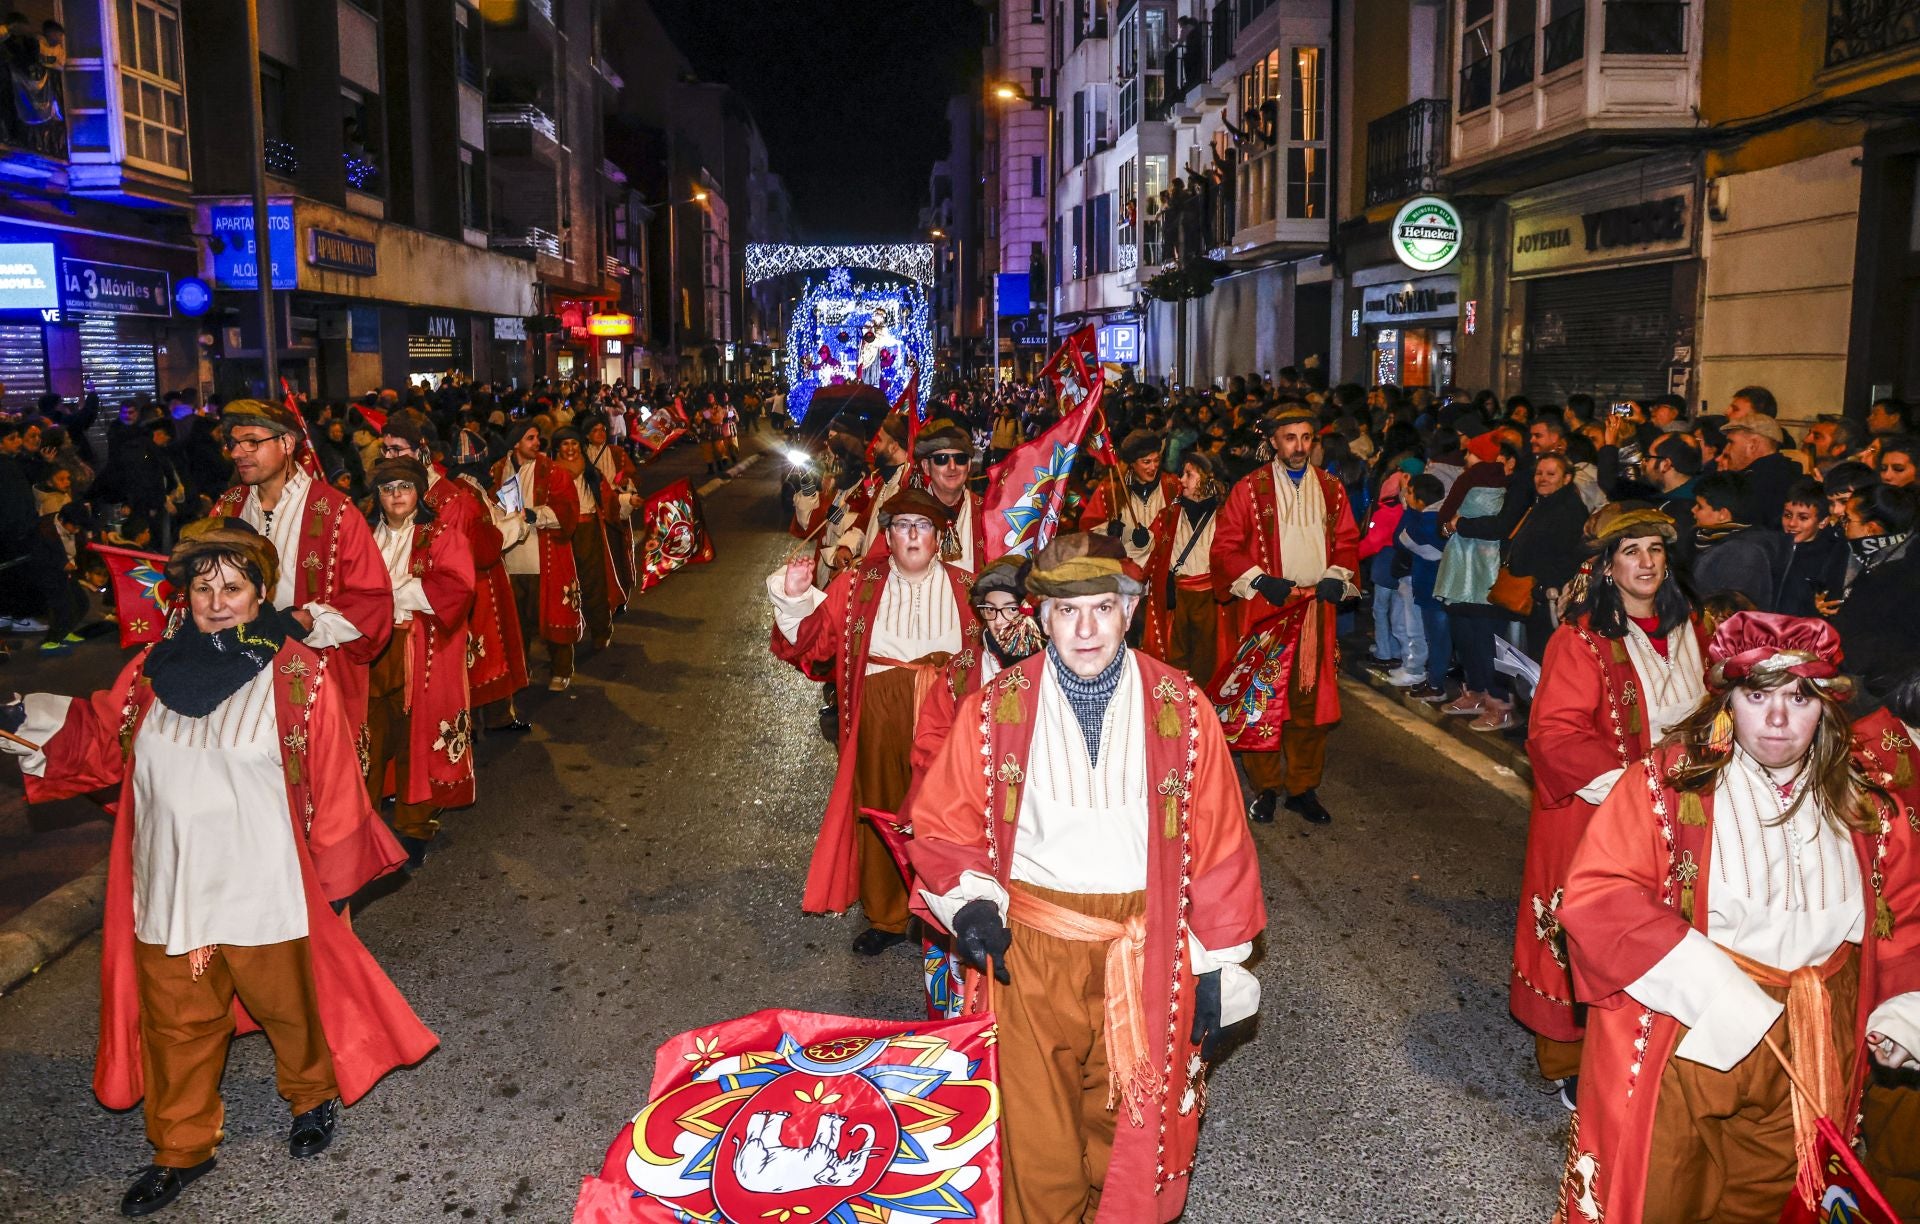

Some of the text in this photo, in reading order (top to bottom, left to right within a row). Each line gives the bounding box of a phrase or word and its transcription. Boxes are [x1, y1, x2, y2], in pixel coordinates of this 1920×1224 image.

[1404, 226, 1455, 240] Heineken
[84, 269, 98, 299] 3
[100, 277, 150, 299] Móviles
[428, 316, 456, 337] ANYA
[1117, 330, 1130, 347] P
